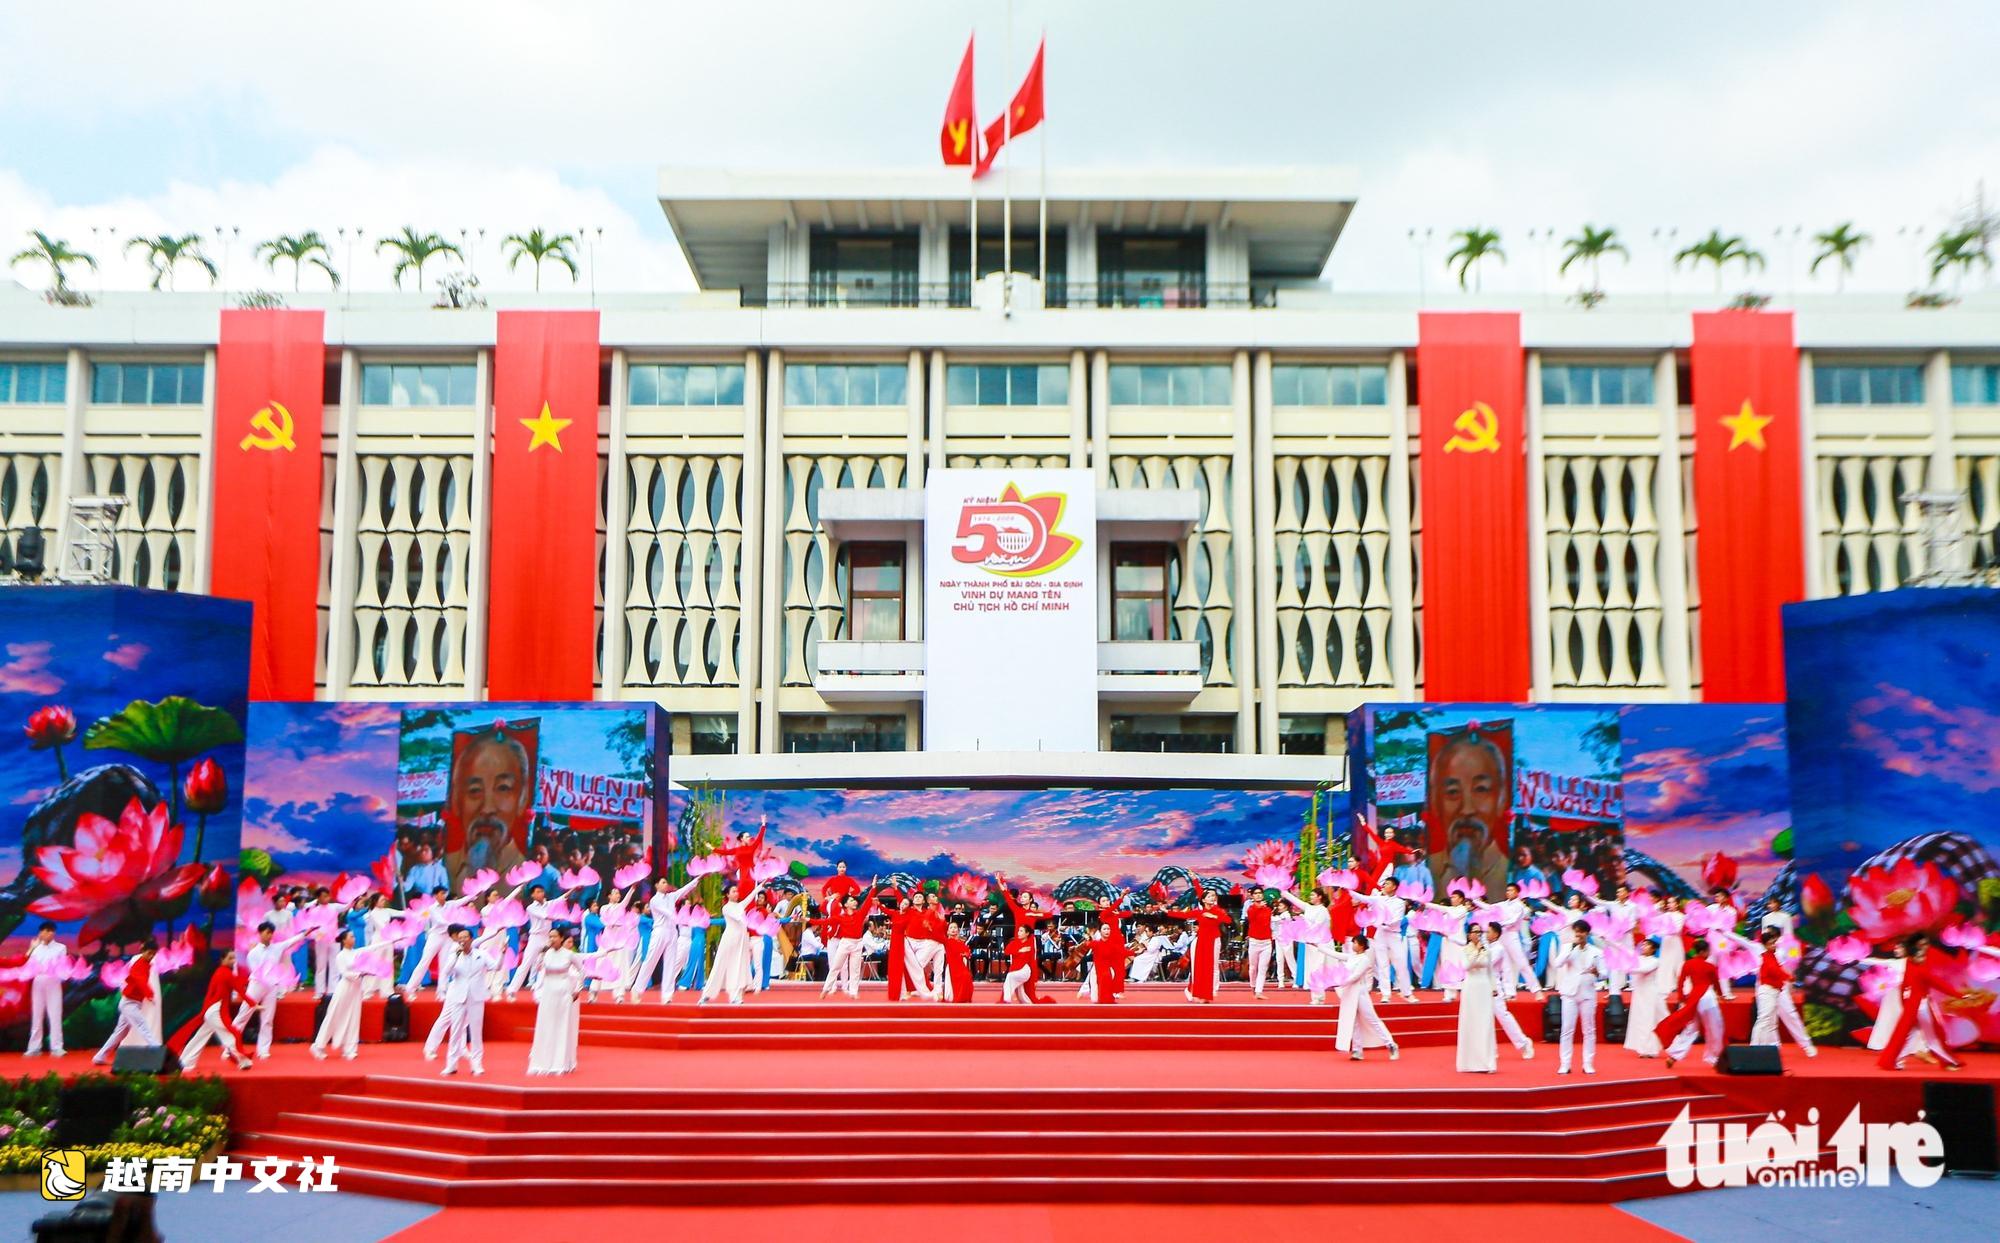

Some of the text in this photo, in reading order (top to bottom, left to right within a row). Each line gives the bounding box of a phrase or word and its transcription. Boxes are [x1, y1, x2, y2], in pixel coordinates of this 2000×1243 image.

[951, 505, 1043, 563] 50
[940, 580, 961, 588] NGÀY
[964, 580, 990, 588] THÀNH
[992, 579, 1008, 588] PHỐ
[1011, 580, 1023, 588] SÀI
[1025, 580, 1042, 588] GÒN
[1048, 580, 1061, 588] GIA
[1063, 580, 1083, 589] ĐỊNH
[961, 591, 986, 599] VINH
[1007, 591, 1038, 599] MANG
[1042, 590, 1062, 599] TÊN
[953, 600, 1070, 612] CHỦ TỊCH HỒ CHÍ MINH
